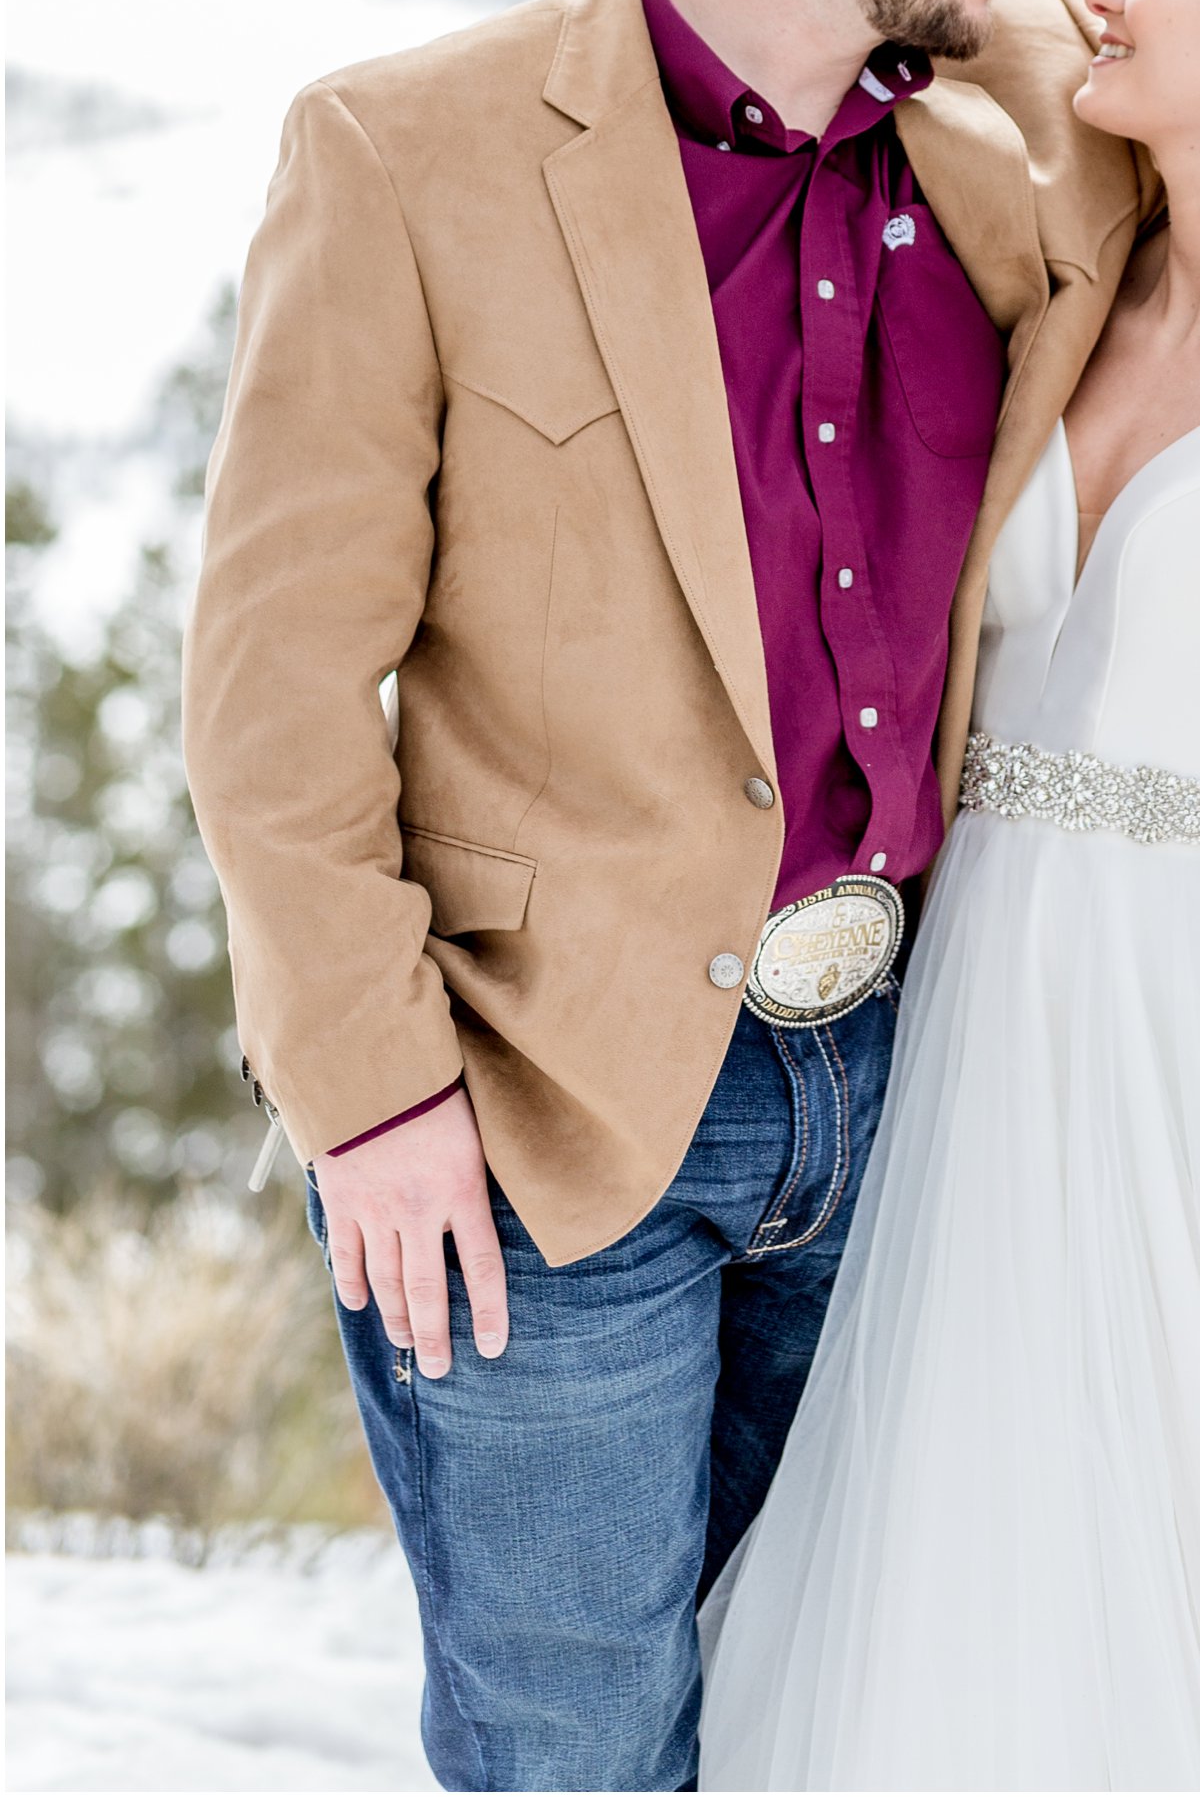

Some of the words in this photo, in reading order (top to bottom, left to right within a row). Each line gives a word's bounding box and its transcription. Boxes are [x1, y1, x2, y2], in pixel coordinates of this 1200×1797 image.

[796, 887, 833, 910] 115TH
[836, 884, 877, 898] ANNUAL
[761, 997, 803, 1019] DADDY
